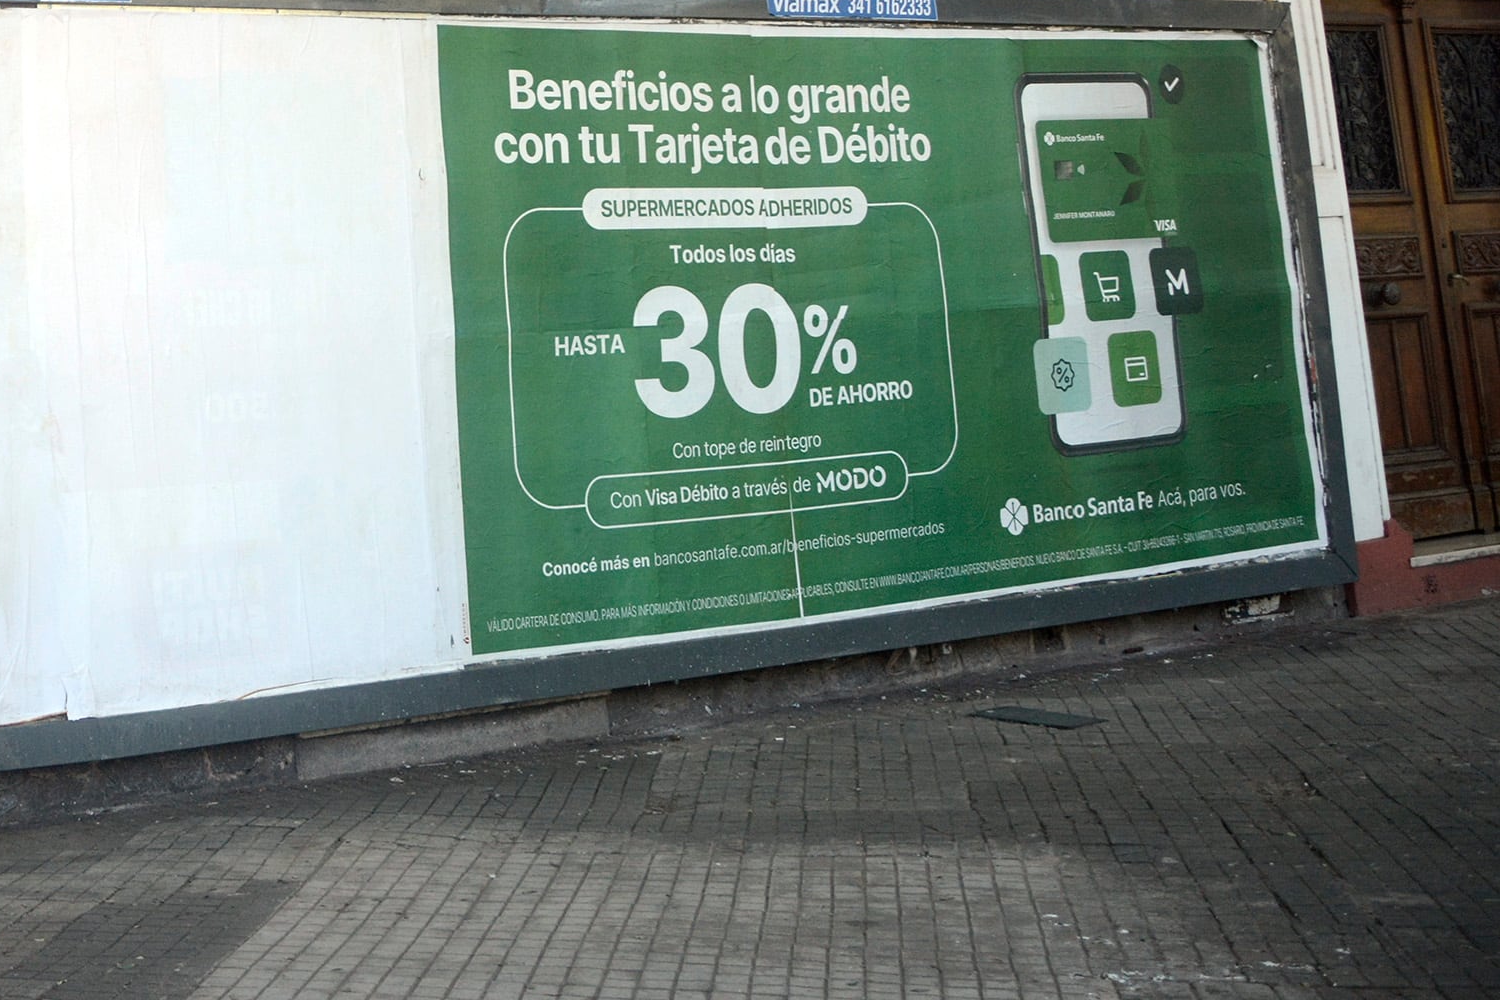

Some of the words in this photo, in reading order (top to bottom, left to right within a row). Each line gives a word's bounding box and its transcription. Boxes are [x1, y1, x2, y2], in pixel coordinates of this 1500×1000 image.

[507, 68, 713, 113] Beneficios
[721, 80, 743, 113] a
[750, 74, 780, 115] lo
[787, 75, 911, 124] grande
[493, 127, 570, 165] con
[578, 128, 620, 165] tu
[627, 123, 760, 175] Tarjeta
[764, 126, 811, 165] de
[817, 121, 932, 164] Débito
[1056, 134, 1077, 143] Banco
[1077, 133, 1096, 142] Santa
[1096, 132, 1105, 142] Fe
[600, 199, 756, 218] SUPERMERCADOS
[757, 197, 853, 217] ADHERIDOS
[1153, 219, 1178, 232] VISA
[669, 243, 726, 264] Todos
[729, 242, 756, 264] los
[759, 241, 796, 264] días
[554, 335, 626, 358] HASTA
[808, 385, 834, 408] DE
[837, 379, 914, 406] AHORRO
[672, 441, 701, 459] Con
[703, 440, 736, 460] tope
[739, 437, 757, 454] de
[759, 434, 822, 453] reintegro
[610, 491, 643, 509] Con
[644, 488, 678, 506] Visa
[680, 484, 729, 503] Débito
[731, 484, 741, 499] a
[742, 479, 788, 498] través
[792, 475, 812, 493] de
[815, 464, 887, 494] MODO
[1033, 503, 1085, 525] Banco
[1088, 496, 1135, 517] Santa
[1137, 490, 1154, 511] Fe
[1157, 486, 1187, 508] Acá,
[1188, 486, 1218, 507] para
[1219, 481, 1247, 497] vos.
[542, 556, 598, 577] Conocé
[600, 555, 630, 572] más
[632, 555, 650, 568] en
[653, 521, 946, 567] bancosantafe.com.ar/beneficios-supermercados
[486, 616, 515, 633] VÁLIDO
[515, 614, 549, 630] CARTERA
[549, 613, 560, 626] DE
[601, 607, 621, 620] PARA
